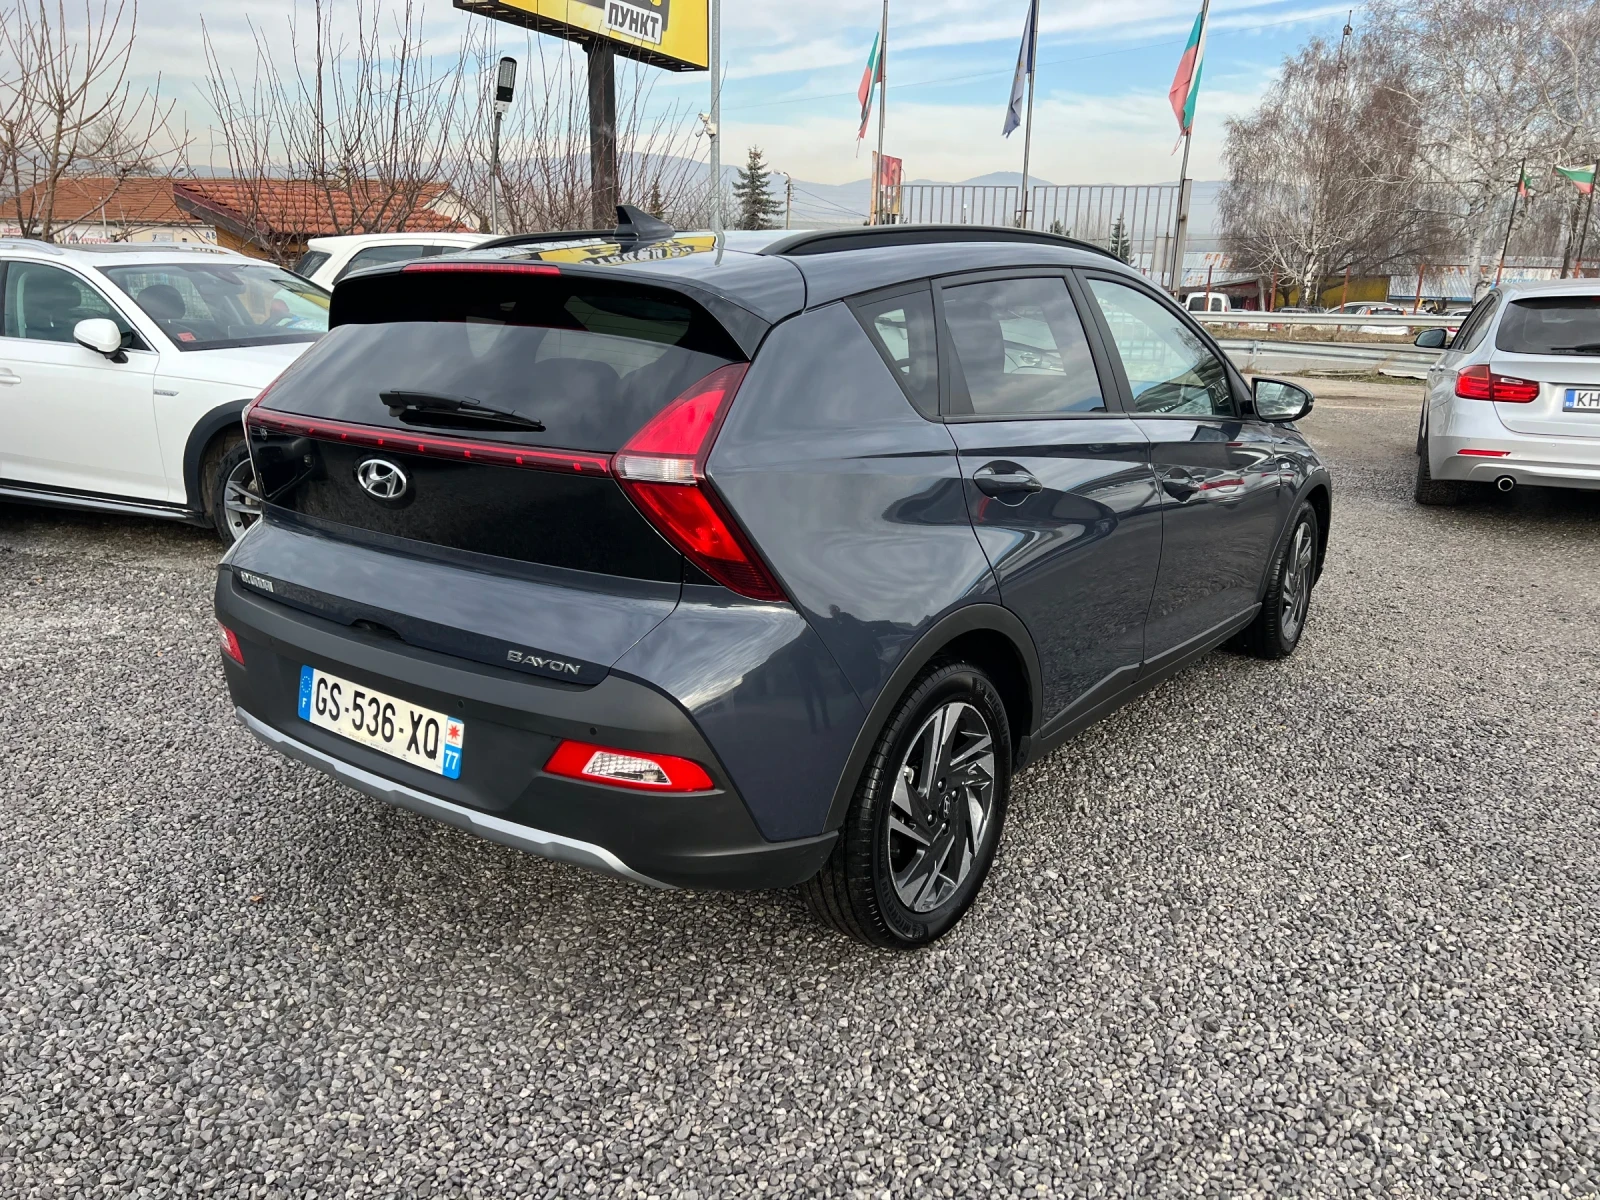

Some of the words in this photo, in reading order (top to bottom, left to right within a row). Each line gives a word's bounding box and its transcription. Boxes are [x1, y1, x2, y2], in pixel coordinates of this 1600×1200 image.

[608, 2, 659, 38] ПУНКТ
[507, 650, 581, 675] BAYON
[302, 698, 308, 708] F
[315, 677, 440, 761] GS-536-XQ
[445, 750, 459, 770] 77
